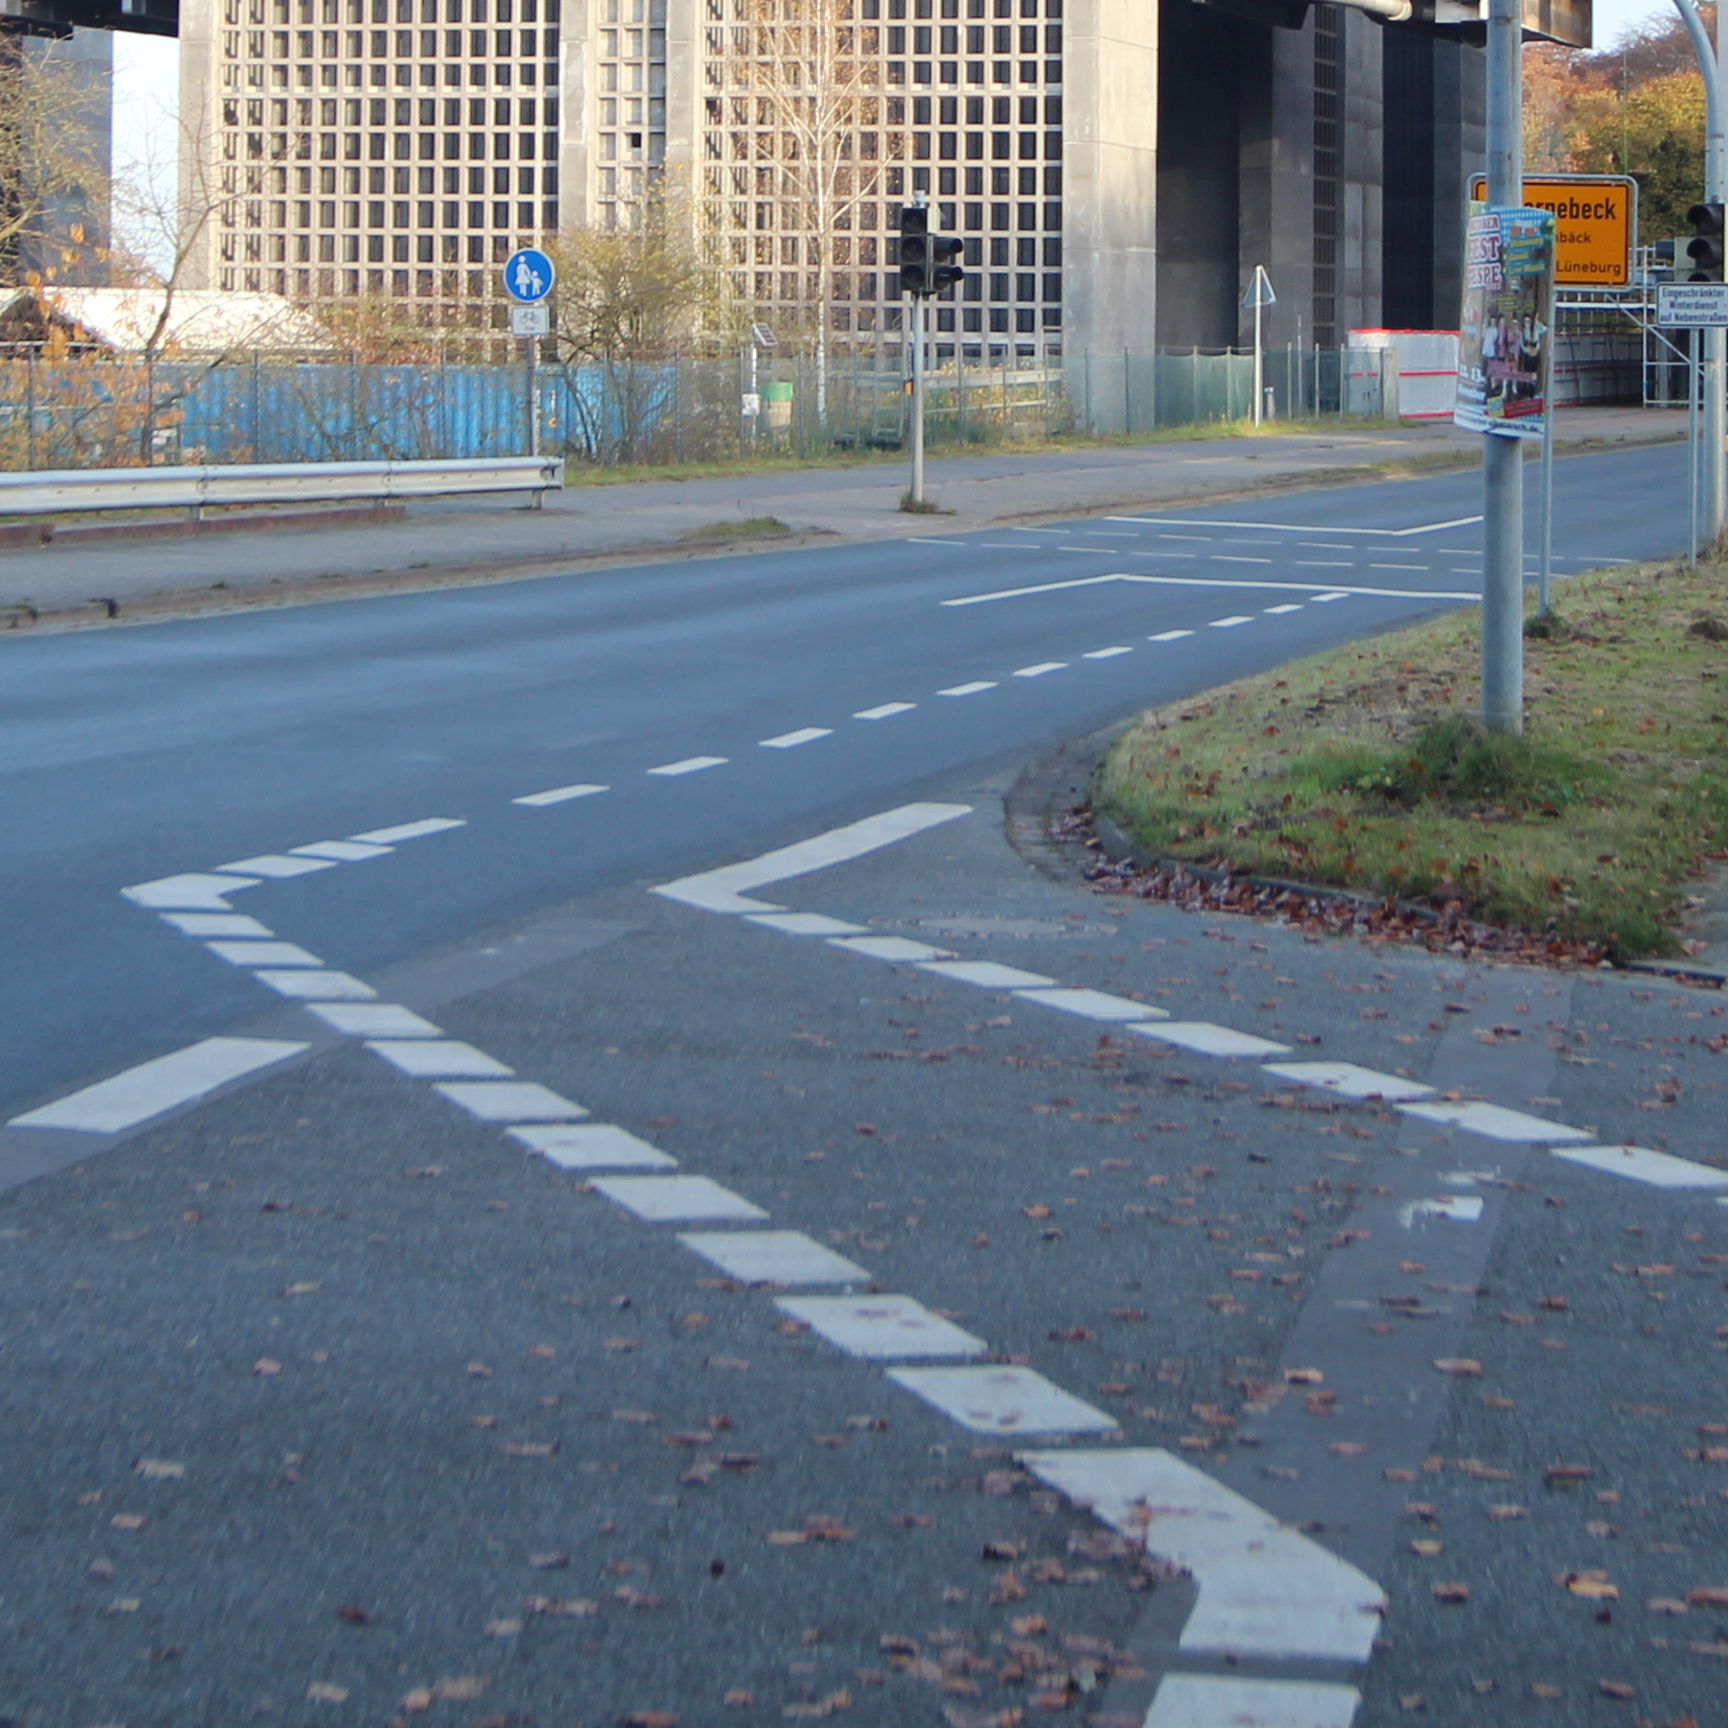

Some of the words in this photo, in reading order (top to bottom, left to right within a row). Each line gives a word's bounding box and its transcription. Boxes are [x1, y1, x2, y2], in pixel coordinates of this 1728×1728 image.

[1556, 260, 1622, 277] Lüneburg
[1662, 287, 1725, 300] Eingeschränkter
[1669, 300, 1718, 310] Winterdienst
[1660, 312, 1672, 322] auf
[1674, 312, 1728, 322] Nebenstraßen
